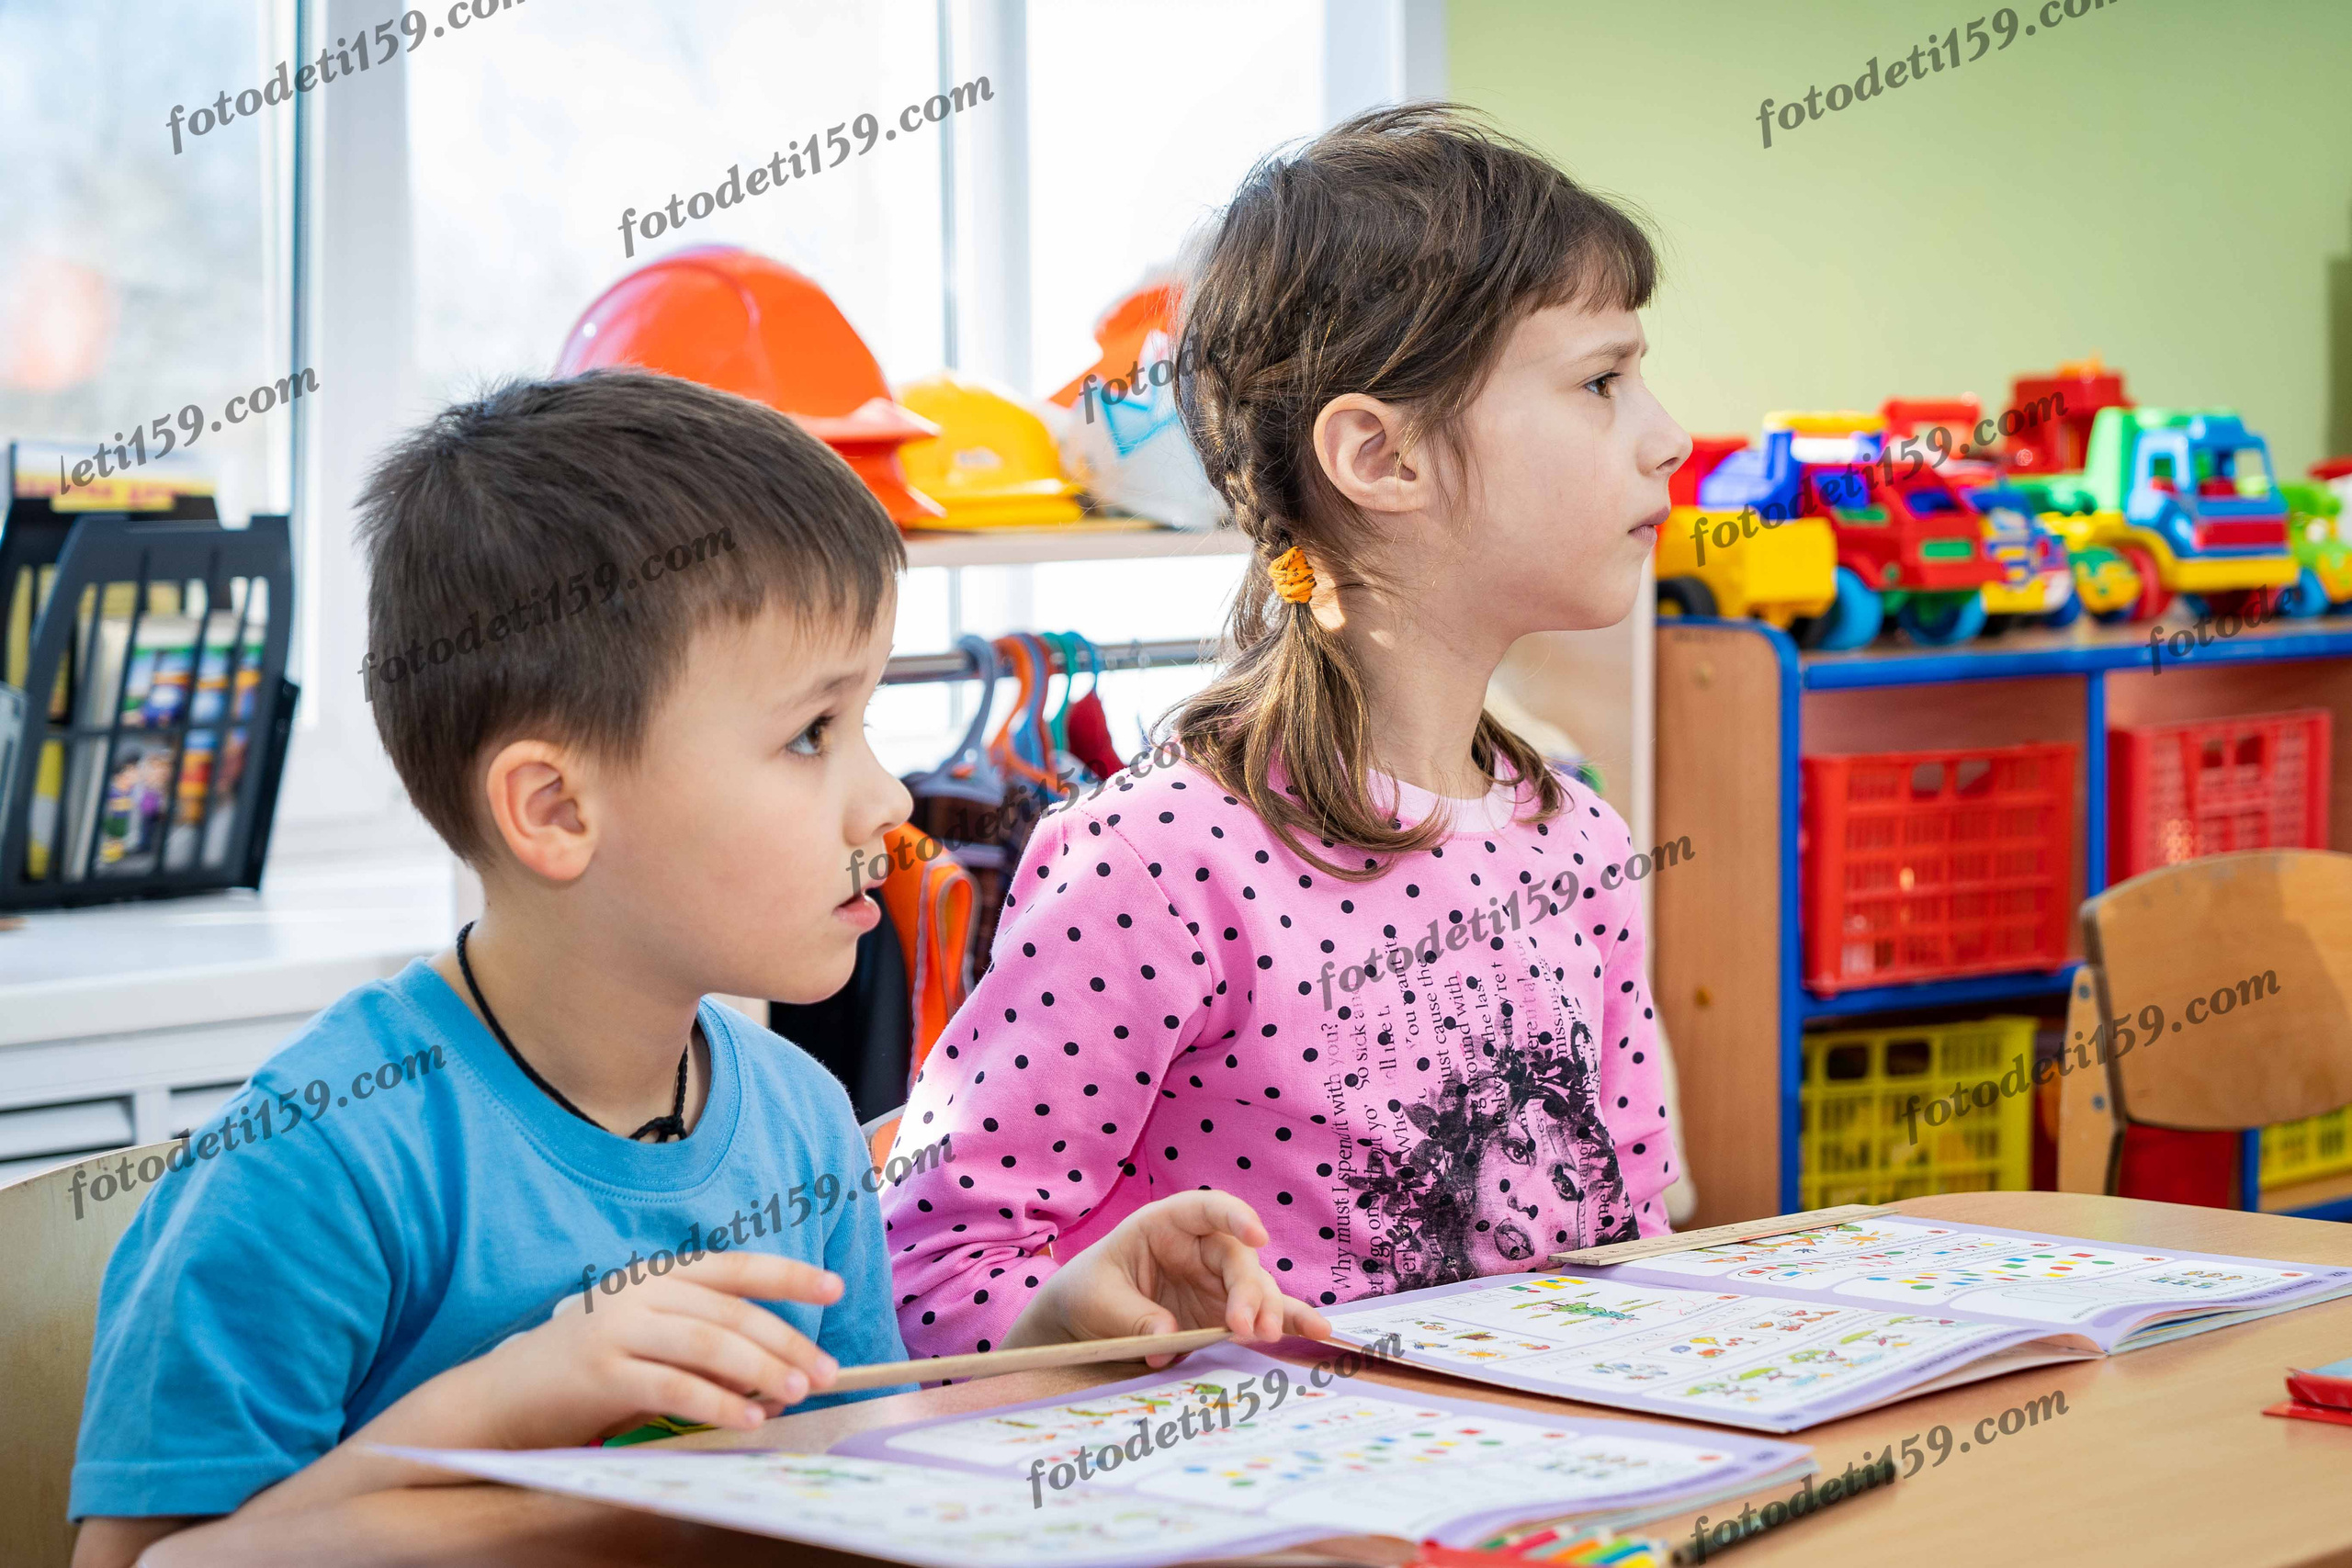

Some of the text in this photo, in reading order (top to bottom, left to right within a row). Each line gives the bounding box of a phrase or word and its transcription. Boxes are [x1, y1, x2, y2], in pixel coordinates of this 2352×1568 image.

[1443, 975, 1466, 1017] with
[1492, 973, 1514, 1035] thy're
[1426, 992, 1447, 1044] cause
[1481, 1014, 1496, 1043] the
[1520, 997, 1539, 1056] eren't
[1321, 1023, 1345, 1066] you?
[1350, 1024, 1368, 1061] sick
[1454, 1021, 1481, 1093] around
[1354, 1066, 1370, 1090] So
[1437, 1049, 1454, 1084] just
[1324, 1074, 1346, 1116] with
[1364, 1135, 1384, 1201] wthout
[1334, 1198, 1351, 1244] must
[1367, 1206, 1381, 1230] on
[1370, 1235, 1390, 1258] go
[1330, 1247, 1356, 1290] Why
